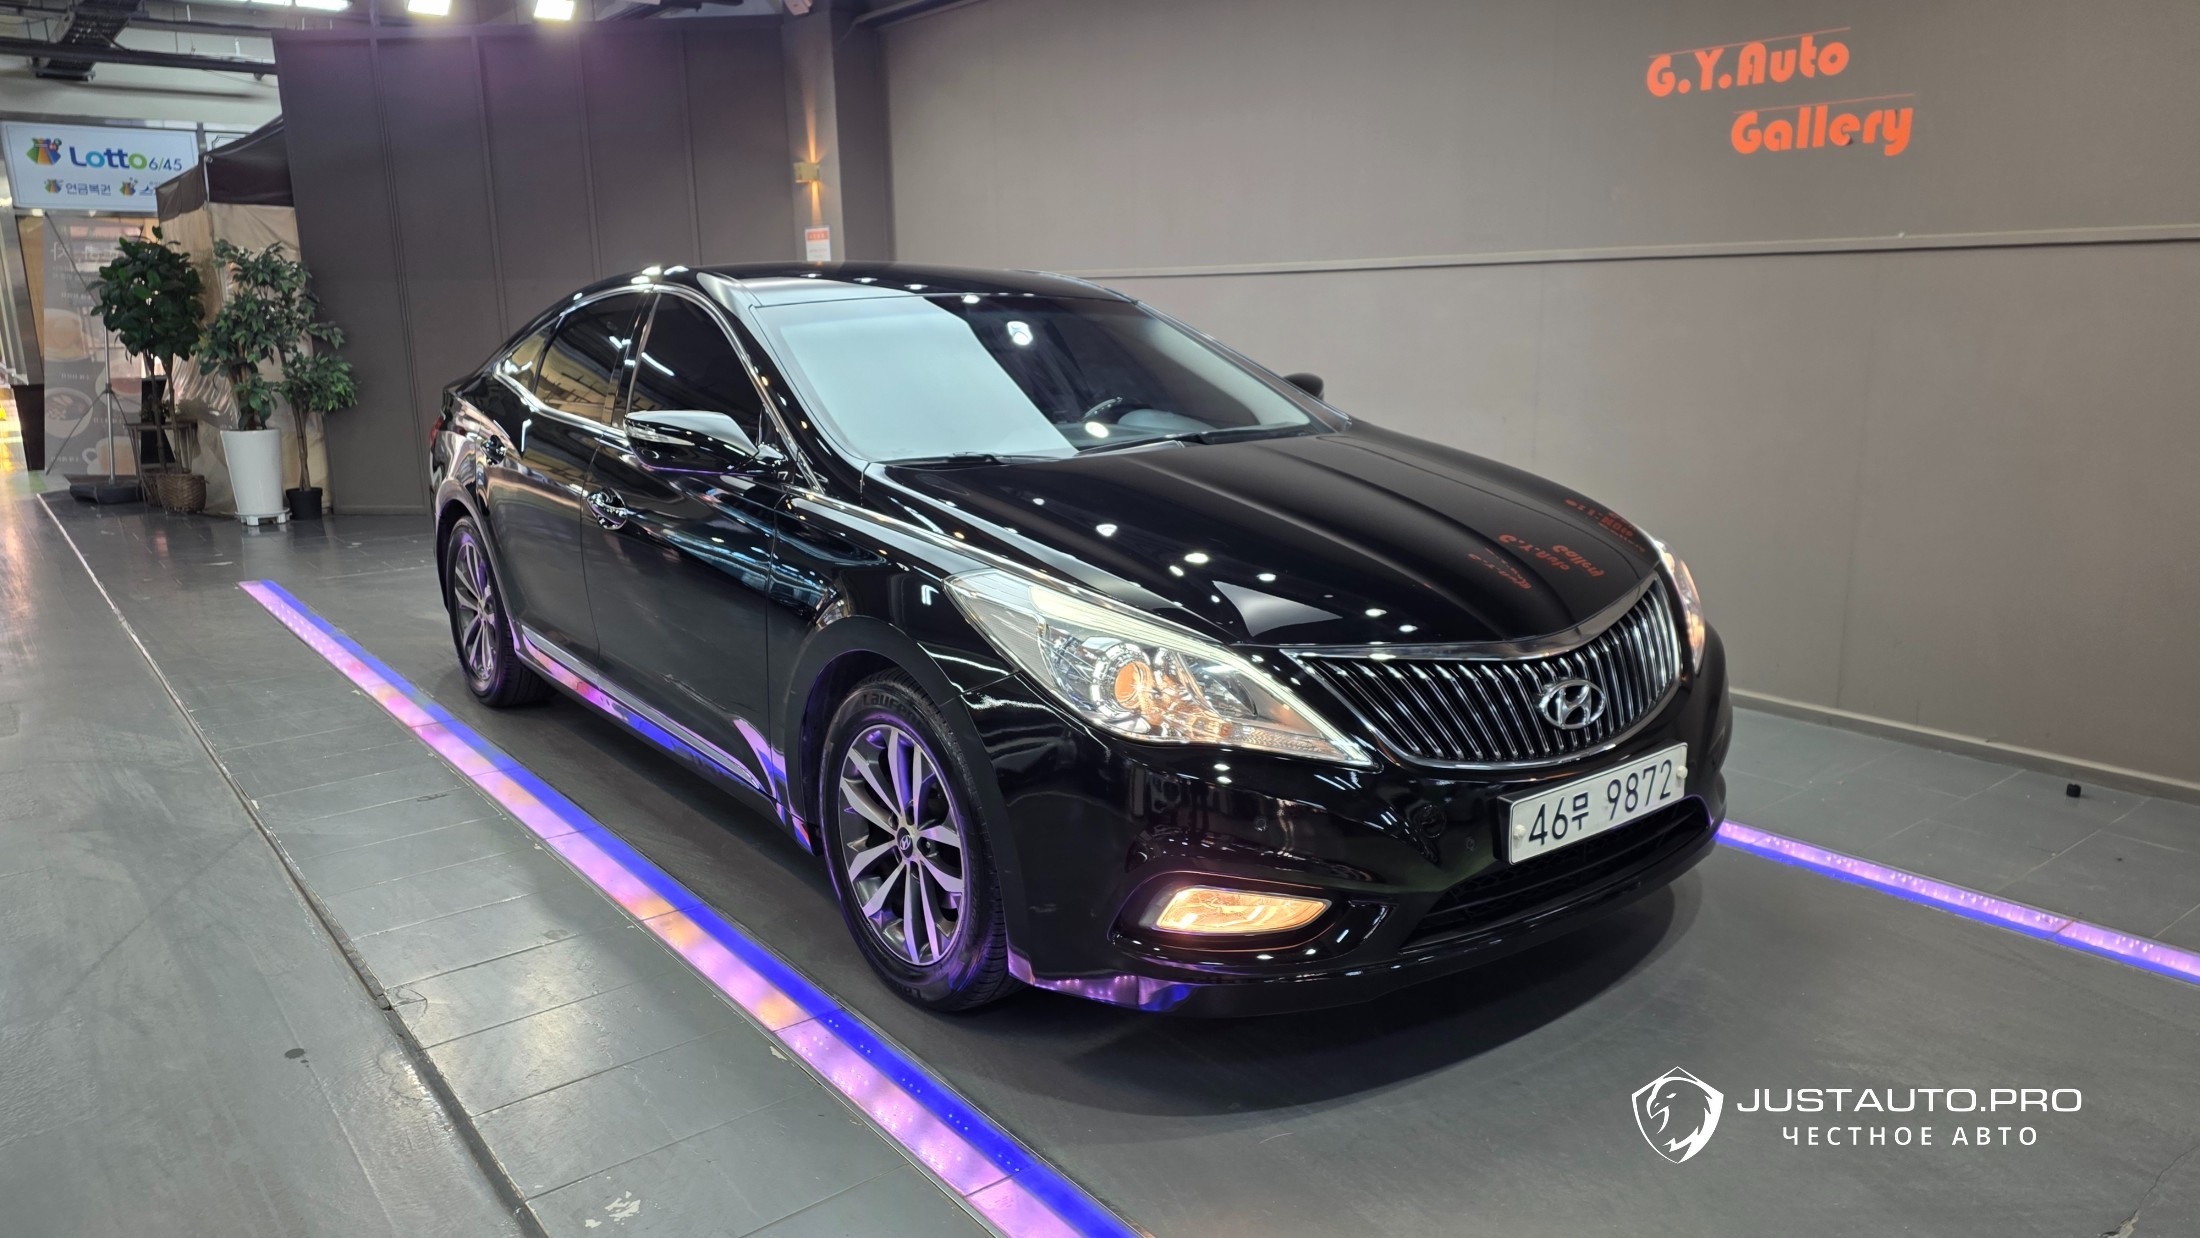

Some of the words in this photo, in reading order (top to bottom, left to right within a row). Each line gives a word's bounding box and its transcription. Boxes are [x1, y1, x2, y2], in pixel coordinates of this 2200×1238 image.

[1731, 104, 1914, 157] Gallery
[69, 145, 147, 171] Lotto
[148, 157, 182, 172] 6/45
[65, 182, 111, 196] 연금복권
[1528, 791, 1589, 846] 46무
[1606, 758, 1673, 821] 9872
